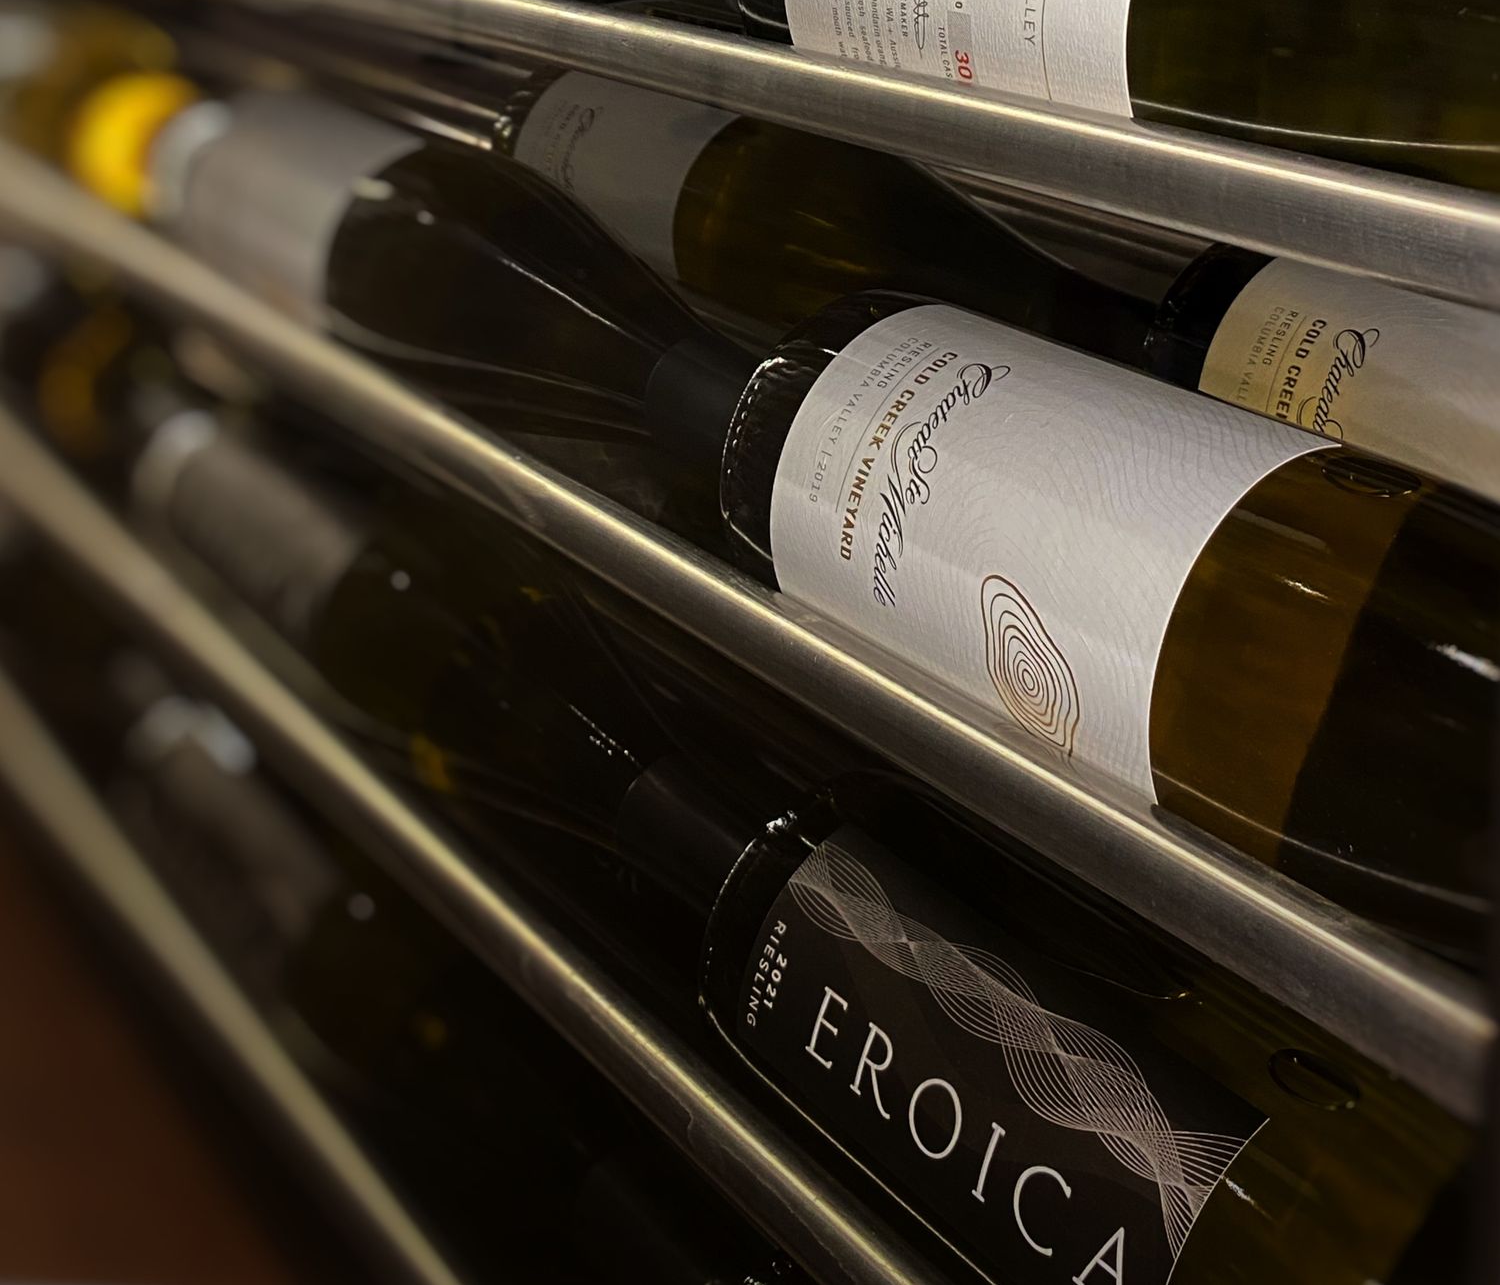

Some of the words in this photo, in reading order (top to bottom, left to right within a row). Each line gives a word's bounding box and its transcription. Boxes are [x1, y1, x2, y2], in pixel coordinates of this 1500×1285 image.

[844, 0, 855, 38] sourced
[860, 25, 874, 62] seafood
[938, 26, 948, 56] TOTAL
[955, 50, 973, 84] 30
[1247, 306, 1284, 365] COLUMBIA
[1262, 310, 1299, 366] RIESLING
[1296, 319, 1327, 359] COLD
[860, 337, 919, 388] COLUMBIA
[877, 342, 932, 389] RIESLING
[914, 351, 958, 385] COLD
[828, 393, 863, 445] VALLEY
[868, 389, 915, 451] CREEK
[907, 363, 1011, 460] Chateau
[809, 462, 828, 503] 2019
[906, 445, 938, 505] Ste
[840, 457, 875, 561] VINEYARD
[746, 920, 787, 1027] RIESLING
[763, 953, 787, 1009] 2021
[805, 985, 1125, 1285] EROICA
